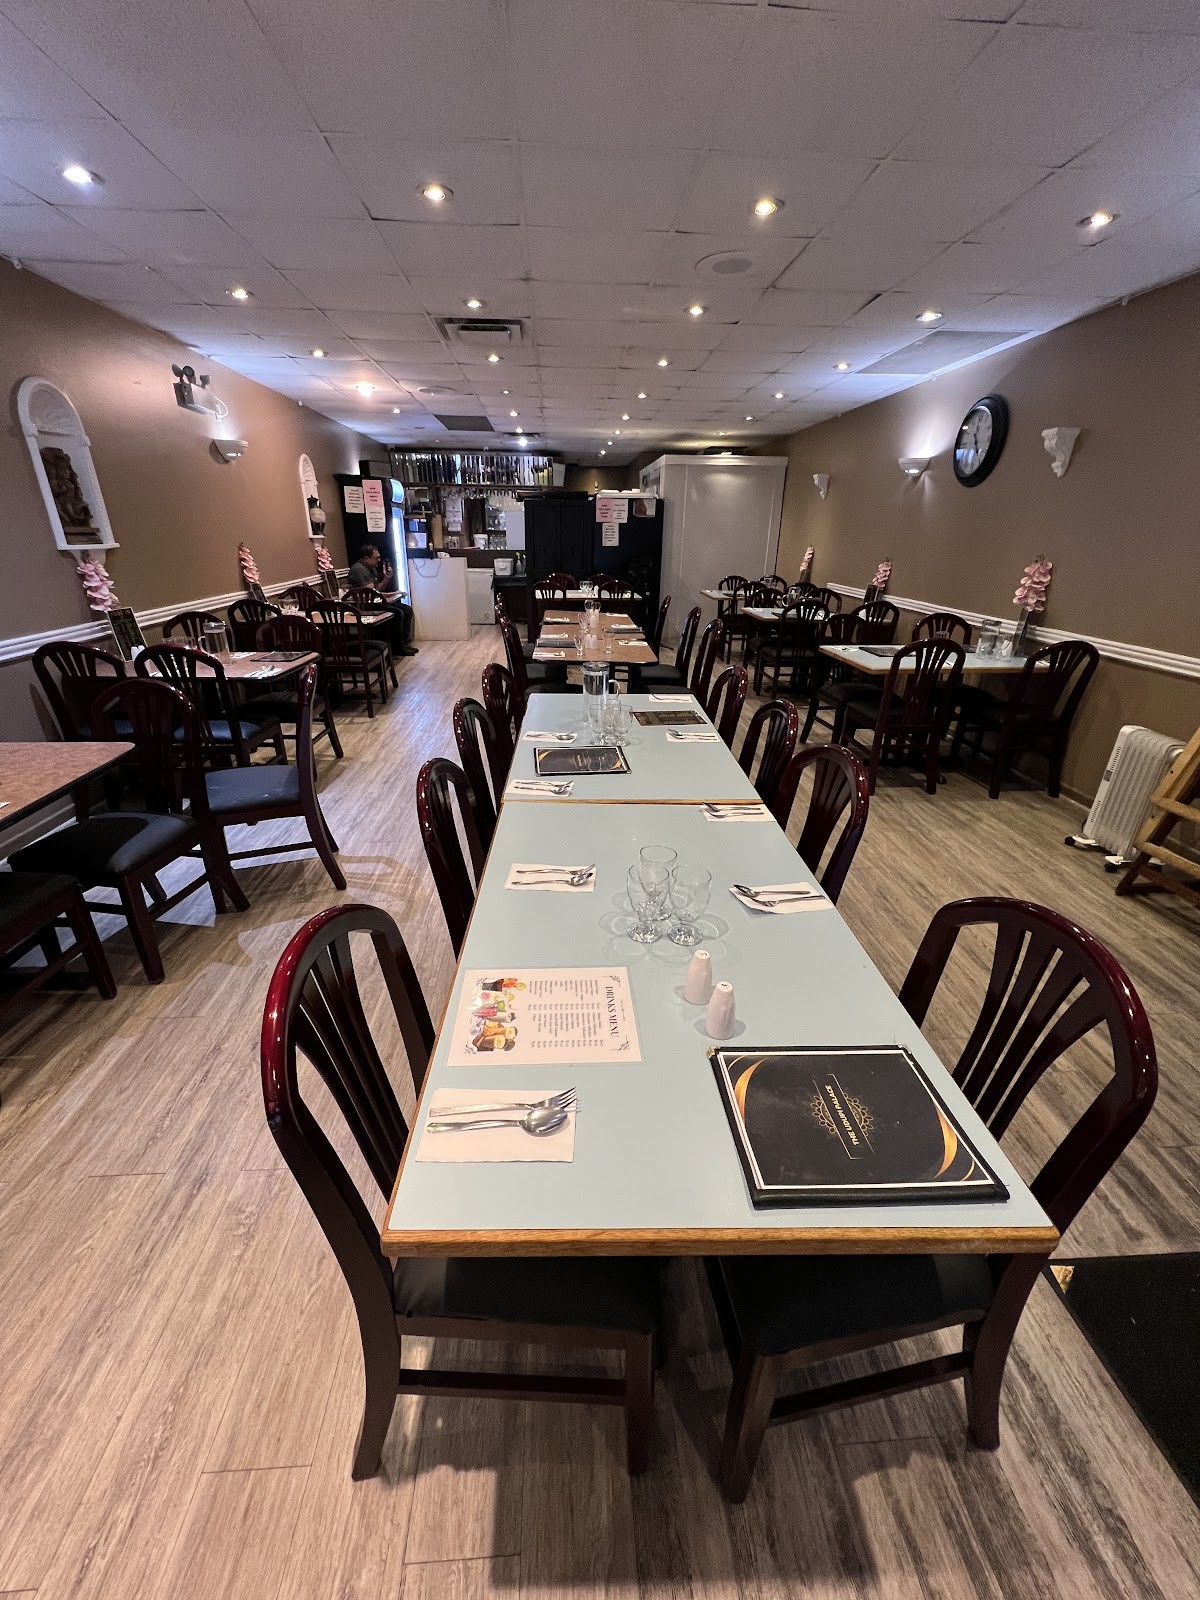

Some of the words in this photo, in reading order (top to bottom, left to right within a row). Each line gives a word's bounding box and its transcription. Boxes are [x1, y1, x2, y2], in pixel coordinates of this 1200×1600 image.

[605, 986, 616, 1013] DRINKS
[609, 1014, 619, 1037] MENU
[825, 1084, 842, 1110] PALACE
[836, 1109, 853, 1131] UDUPI
[848, 1131, 860, 1146] THE
